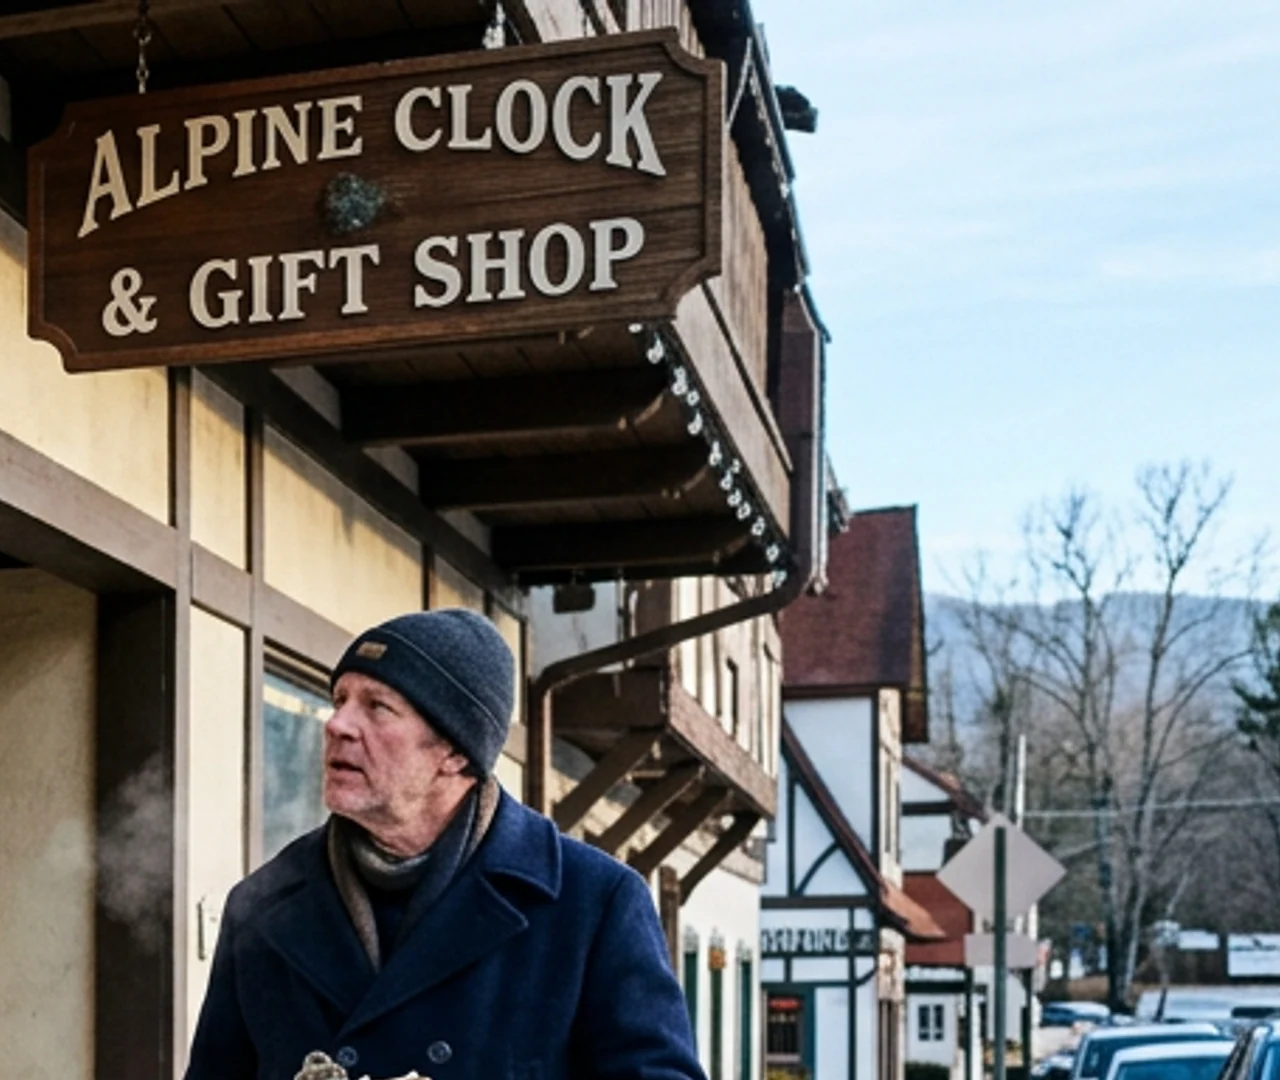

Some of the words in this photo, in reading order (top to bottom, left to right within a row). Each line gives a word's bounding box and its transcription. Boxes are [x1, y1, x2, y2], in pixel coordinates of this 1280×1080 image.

[77, 95, 363, 239] ALPINE
[394, 71, 667, 176] CLOCK
[102, 267, 157, 337] &
[189, 244, 380, 328] GIFT
[414, 217, 645, 308] SHOP
